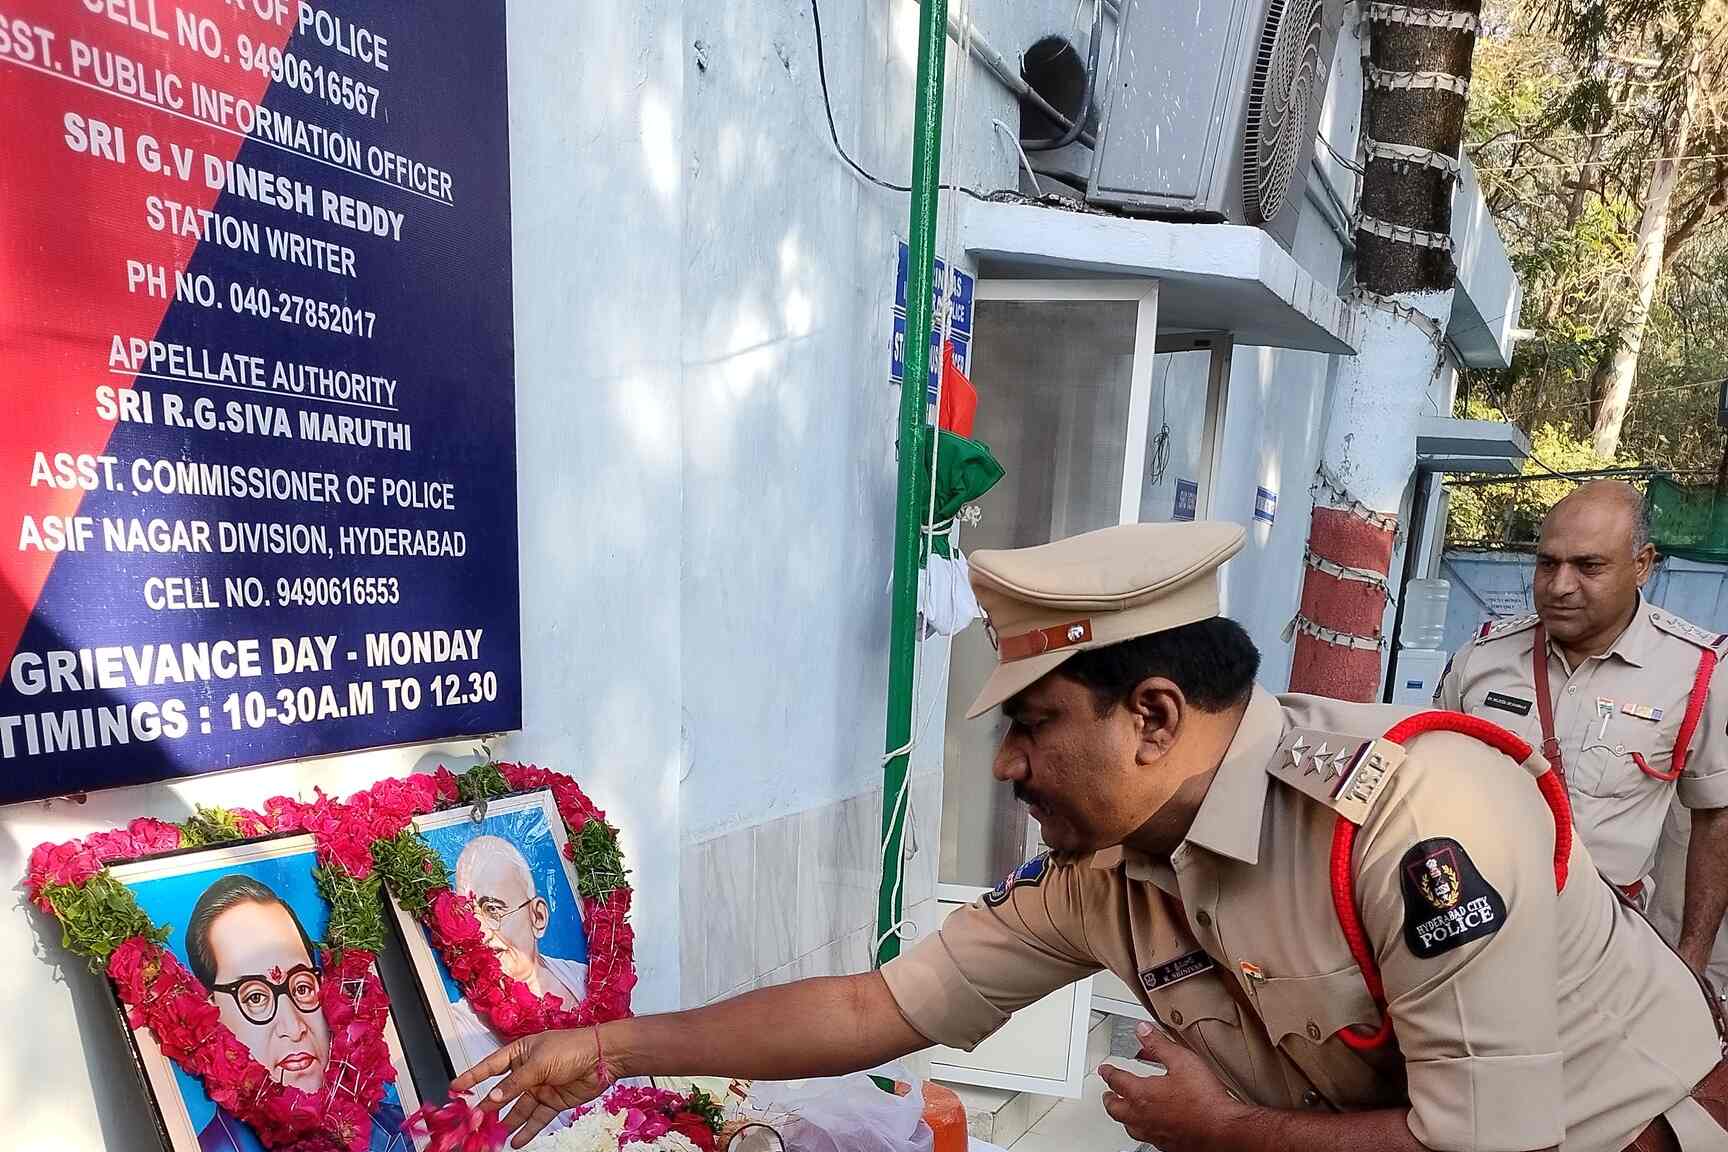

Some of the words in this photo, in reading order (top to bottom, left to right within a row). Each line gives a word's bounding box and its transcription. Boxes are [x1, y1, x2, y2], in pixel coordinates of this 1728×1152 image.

[176, 8, 230, 63] NO.
[237, 34, 380, 118] 9490616567
[299, 4, 389, 71] POLICE
[70, 40, 183, 109] PUBLIC
[192, 82, 361, 170] INFORMATION
[367, 145, 454, 200] OFFICER
[64, 112, 125, 164] SRI
[137, 138, 194, 181] G.V
[205, 154, 314, 216] DINESH
[322, 190, 404, 241] REDDY
[147, 195, 259, 254] STATION
[266, 225, 357, 278] WRITER
[127, 259, 166, 299] PH
[175, 268, 223, 310] NO.
[230, 281, 376, 339] 040-27852017
[109, 335, 266, 388] APPELLATE
[272, 361, 398, 406] AUTHORITY
[96, 385, 152, 424] SRI
[163, 393, 292, 439] R.G.SIVA
[299, 411, 411, 451] MARUTHI
[30, 451, 124, 492] ASST.
[131, 459, 341, 503] COMMISSIONER
[347, 474, 375, 505] OF
[383, 478, 455, 510] POLICE
[19, 515, 93, 552] ASIF
[103, 518, 212, 554] NAGAR
[219, 521, 333, 559] DIVISION,
[339, 527, 467, 558] HYDERABAD
[144, 577, 220, 610] CELL
[225, 577, 270, 609] NO.
[277, 576, 400, 606] 9490616553
[10, 639, 262, 696] GRIEVANCE
[273, 634, 337, 676] DAY
[366, 629, 483, 666] MONDAY
[0, 698, 189, 758] TIMINGS
[223, 682, 374, 731] 10-30A.M
[383, 678, 421, 711] TO
[431, 671, 498, 707] 12.30
[1415, 905, 1467, 935] HYDERABAD
[1467, 895, 1489, 914] CITY
[1419, 907, 1494, 949] POLICE
